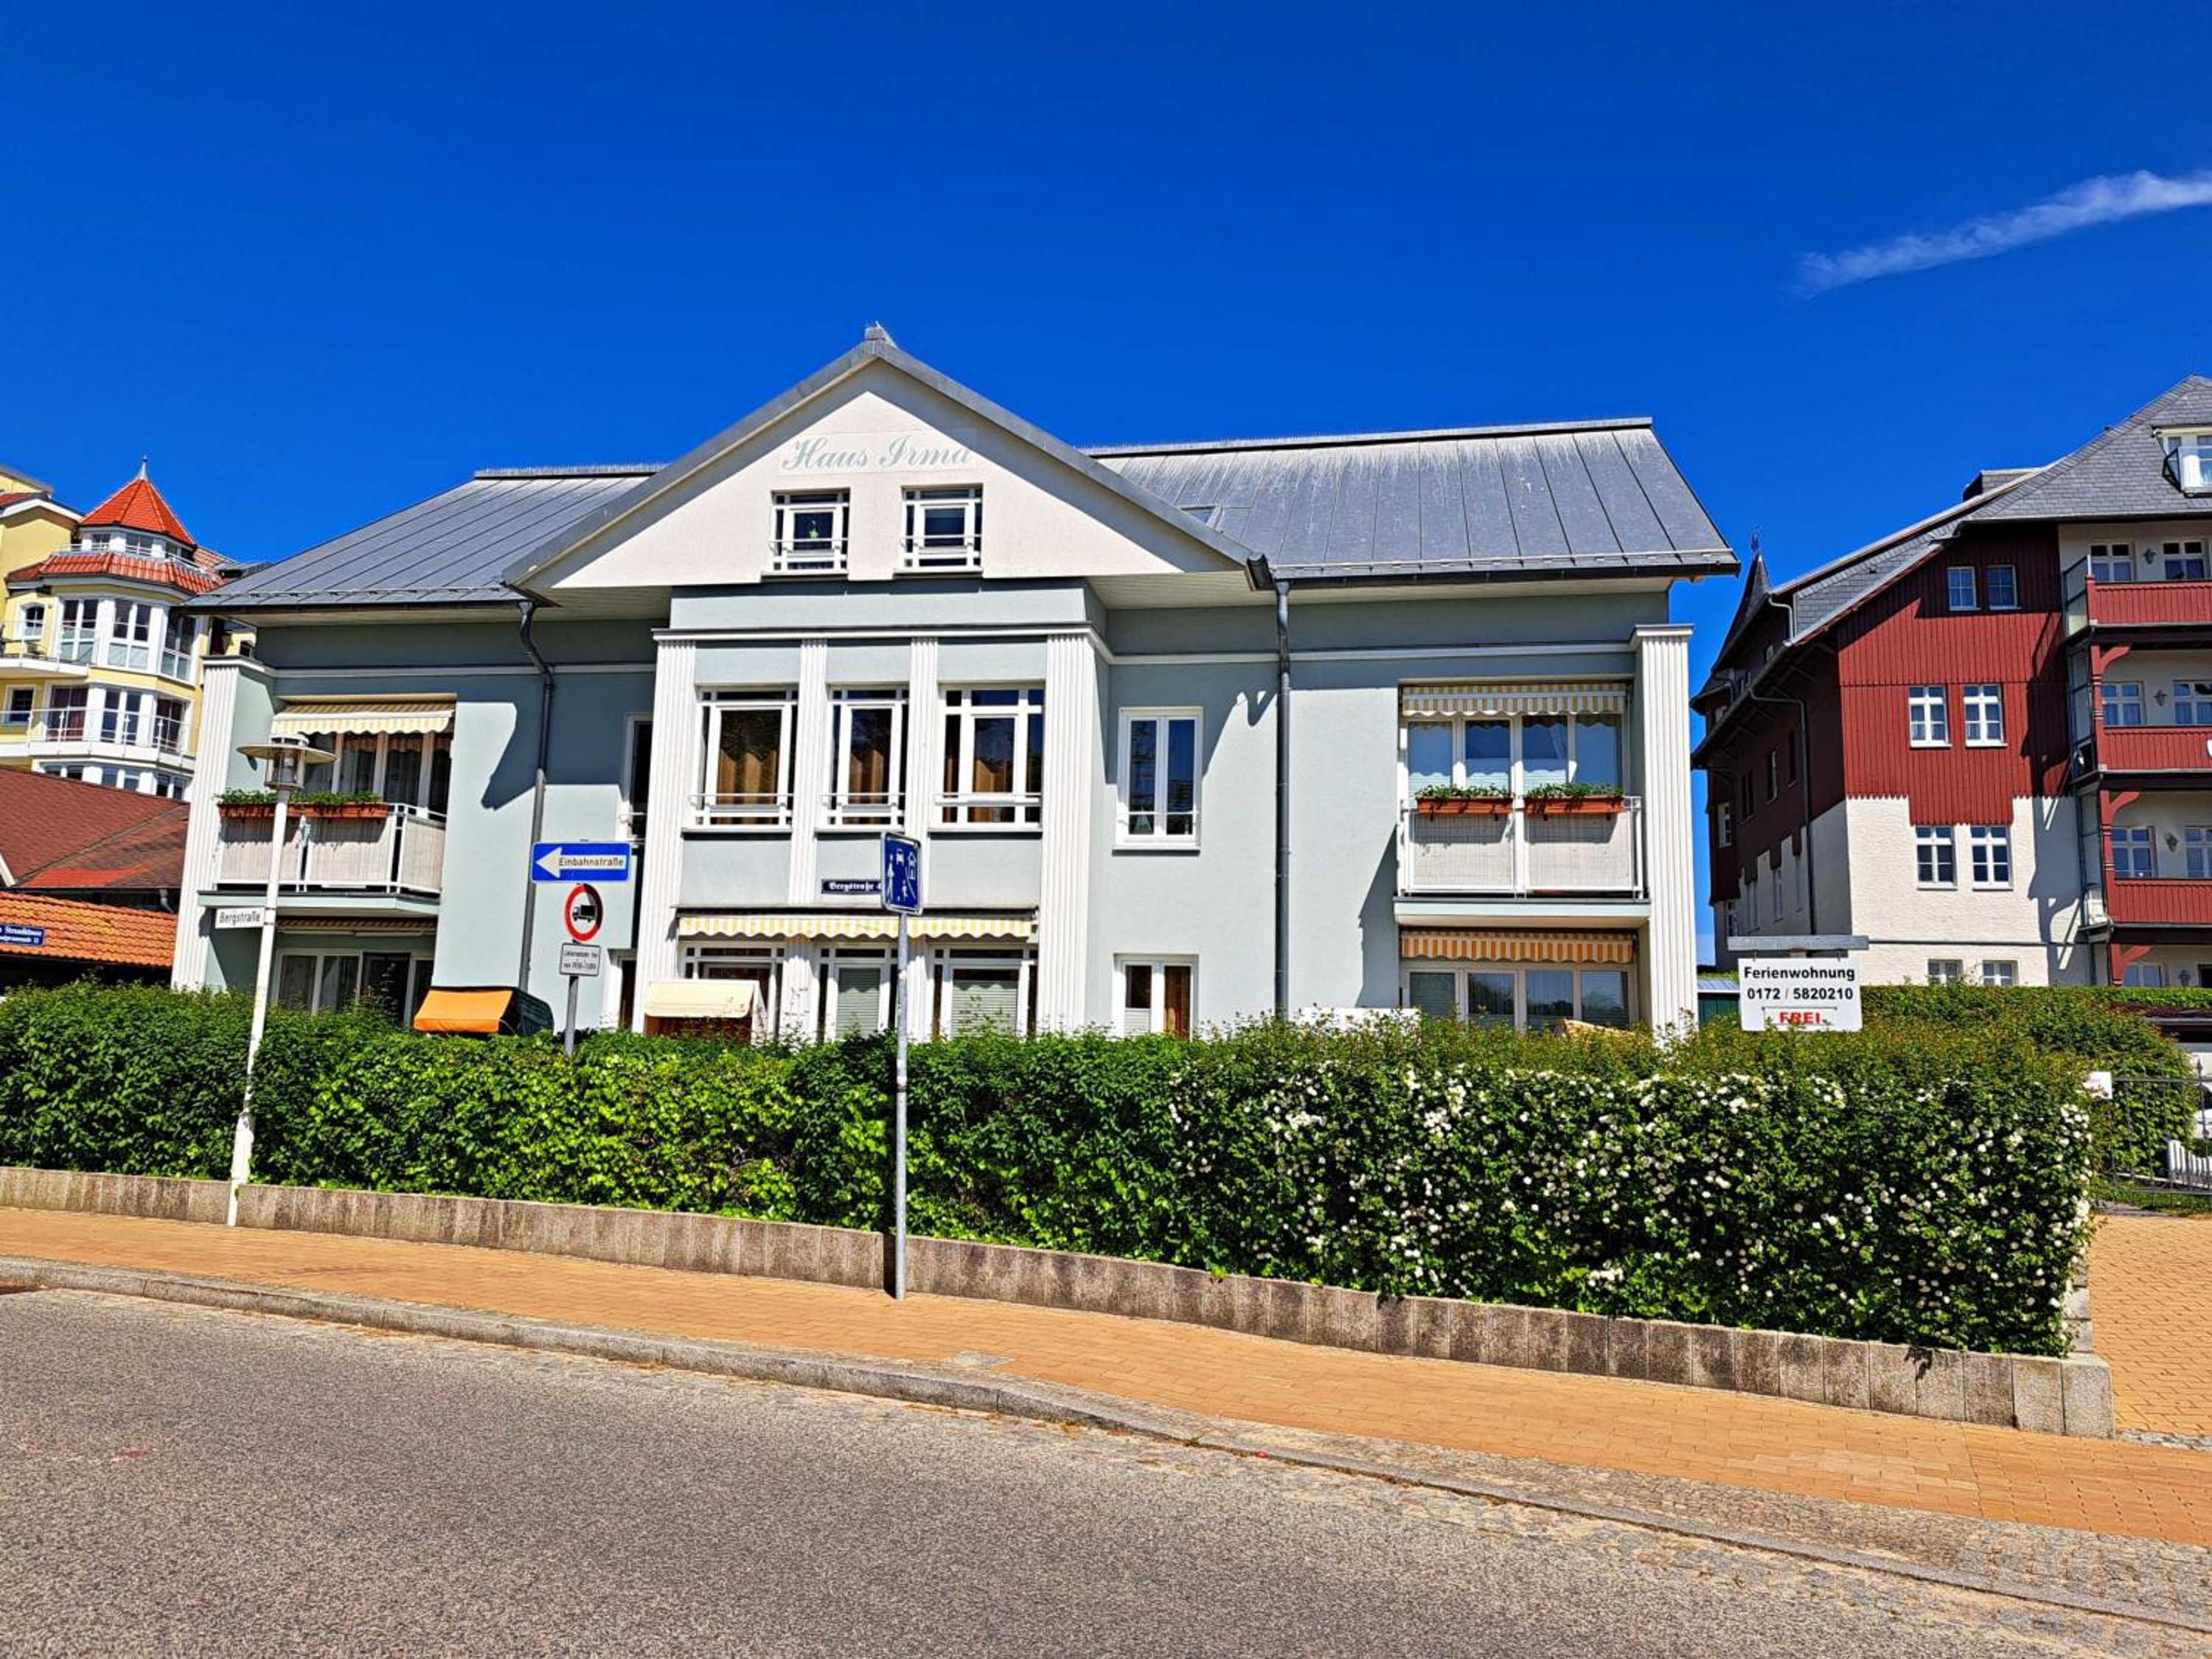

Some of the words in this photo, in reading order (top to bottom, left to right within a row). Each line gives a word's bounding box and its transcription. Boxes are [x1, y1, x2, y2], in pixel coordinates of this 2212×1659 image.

[783, 436, 869, 470] Haus
[879, 434, 970, 467] Irma
[558, 857, 624, 867] Einbahnstraße
[219, 911, 260, 925] Bergstraße
[1744, 966, 1855, 981] Ferienwohnung
[1747, 987, 1781, 1000] 0172
[1792, 987, 1854, 1000] 5820210
[1778, 1012, 1821, 1025] FREI
